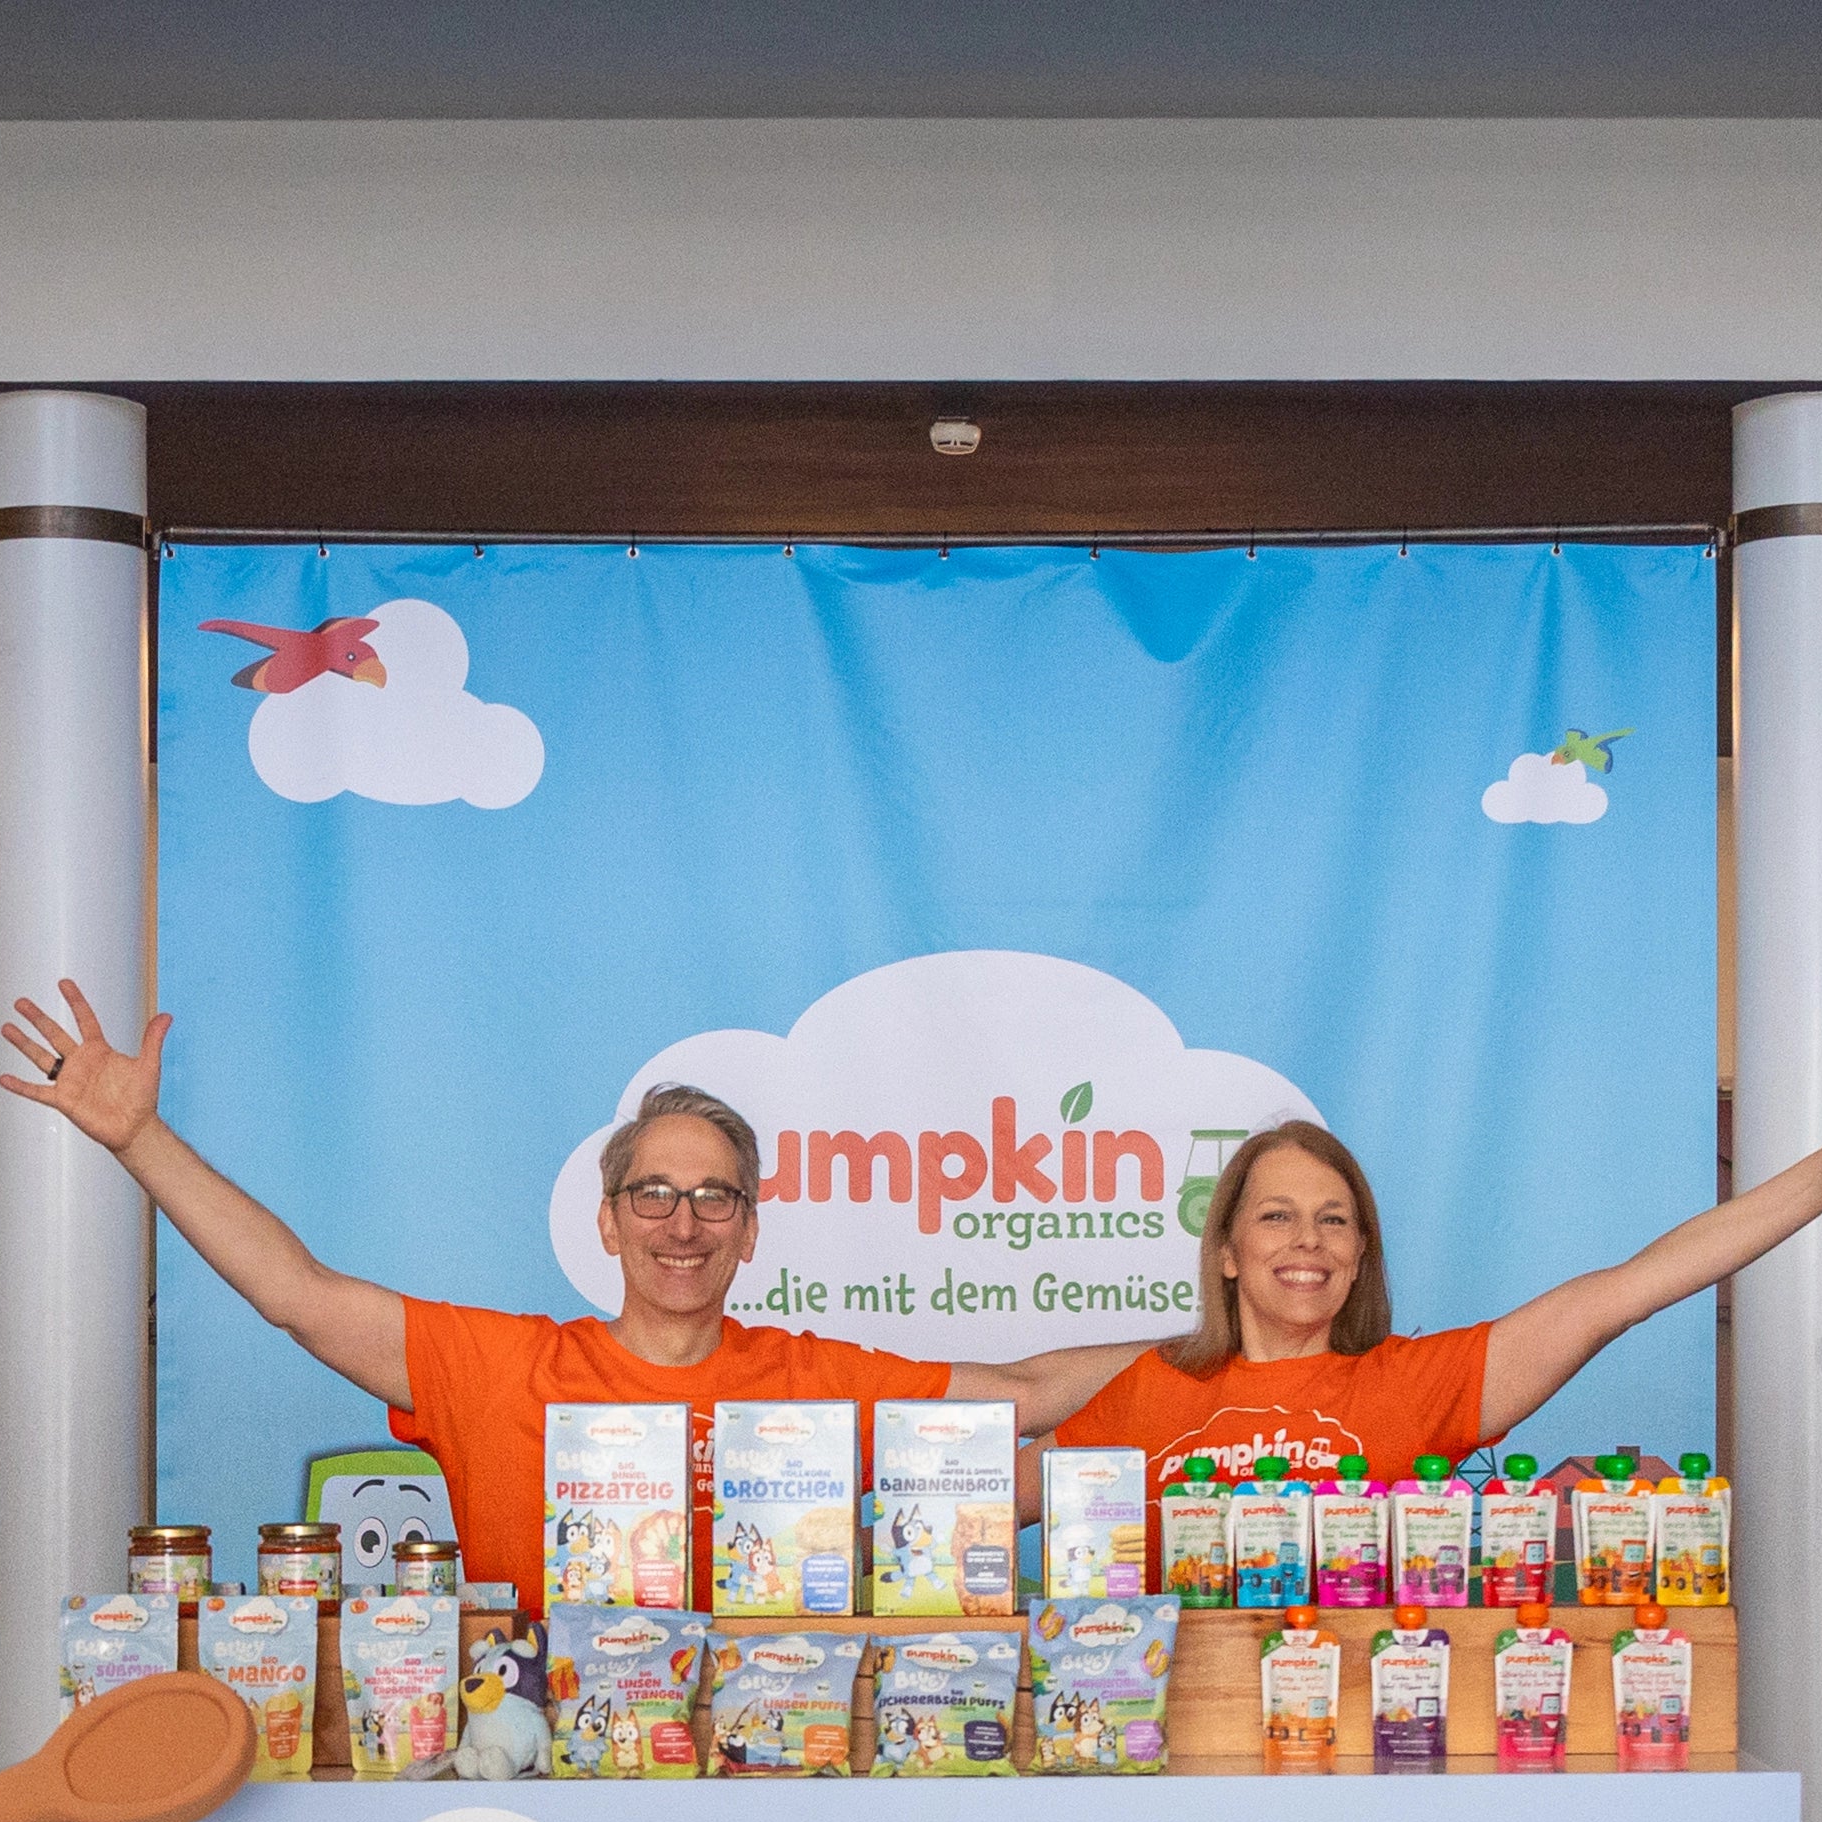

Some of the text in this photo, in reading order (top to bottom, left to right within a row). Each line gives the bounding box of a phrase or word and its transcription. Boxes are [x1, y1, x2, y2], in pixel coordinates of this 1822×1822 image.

[759, 1081, 1165, 1234] umpkin
[953, 1211, 1165, 1250] organics
[843, 1273, 915, 1315] mit
[930, 1267, 1017, 1315] dem
[1158, 1429, 1305, 1482] pmpkin
[598, 1630, 649, 1647] pumpkin
[1073, 1621, 1122, 1637] pumpkin
[754, 1651, 804, 1664] pumpkin
[906, 1649, 957, 1663] pumpkin
